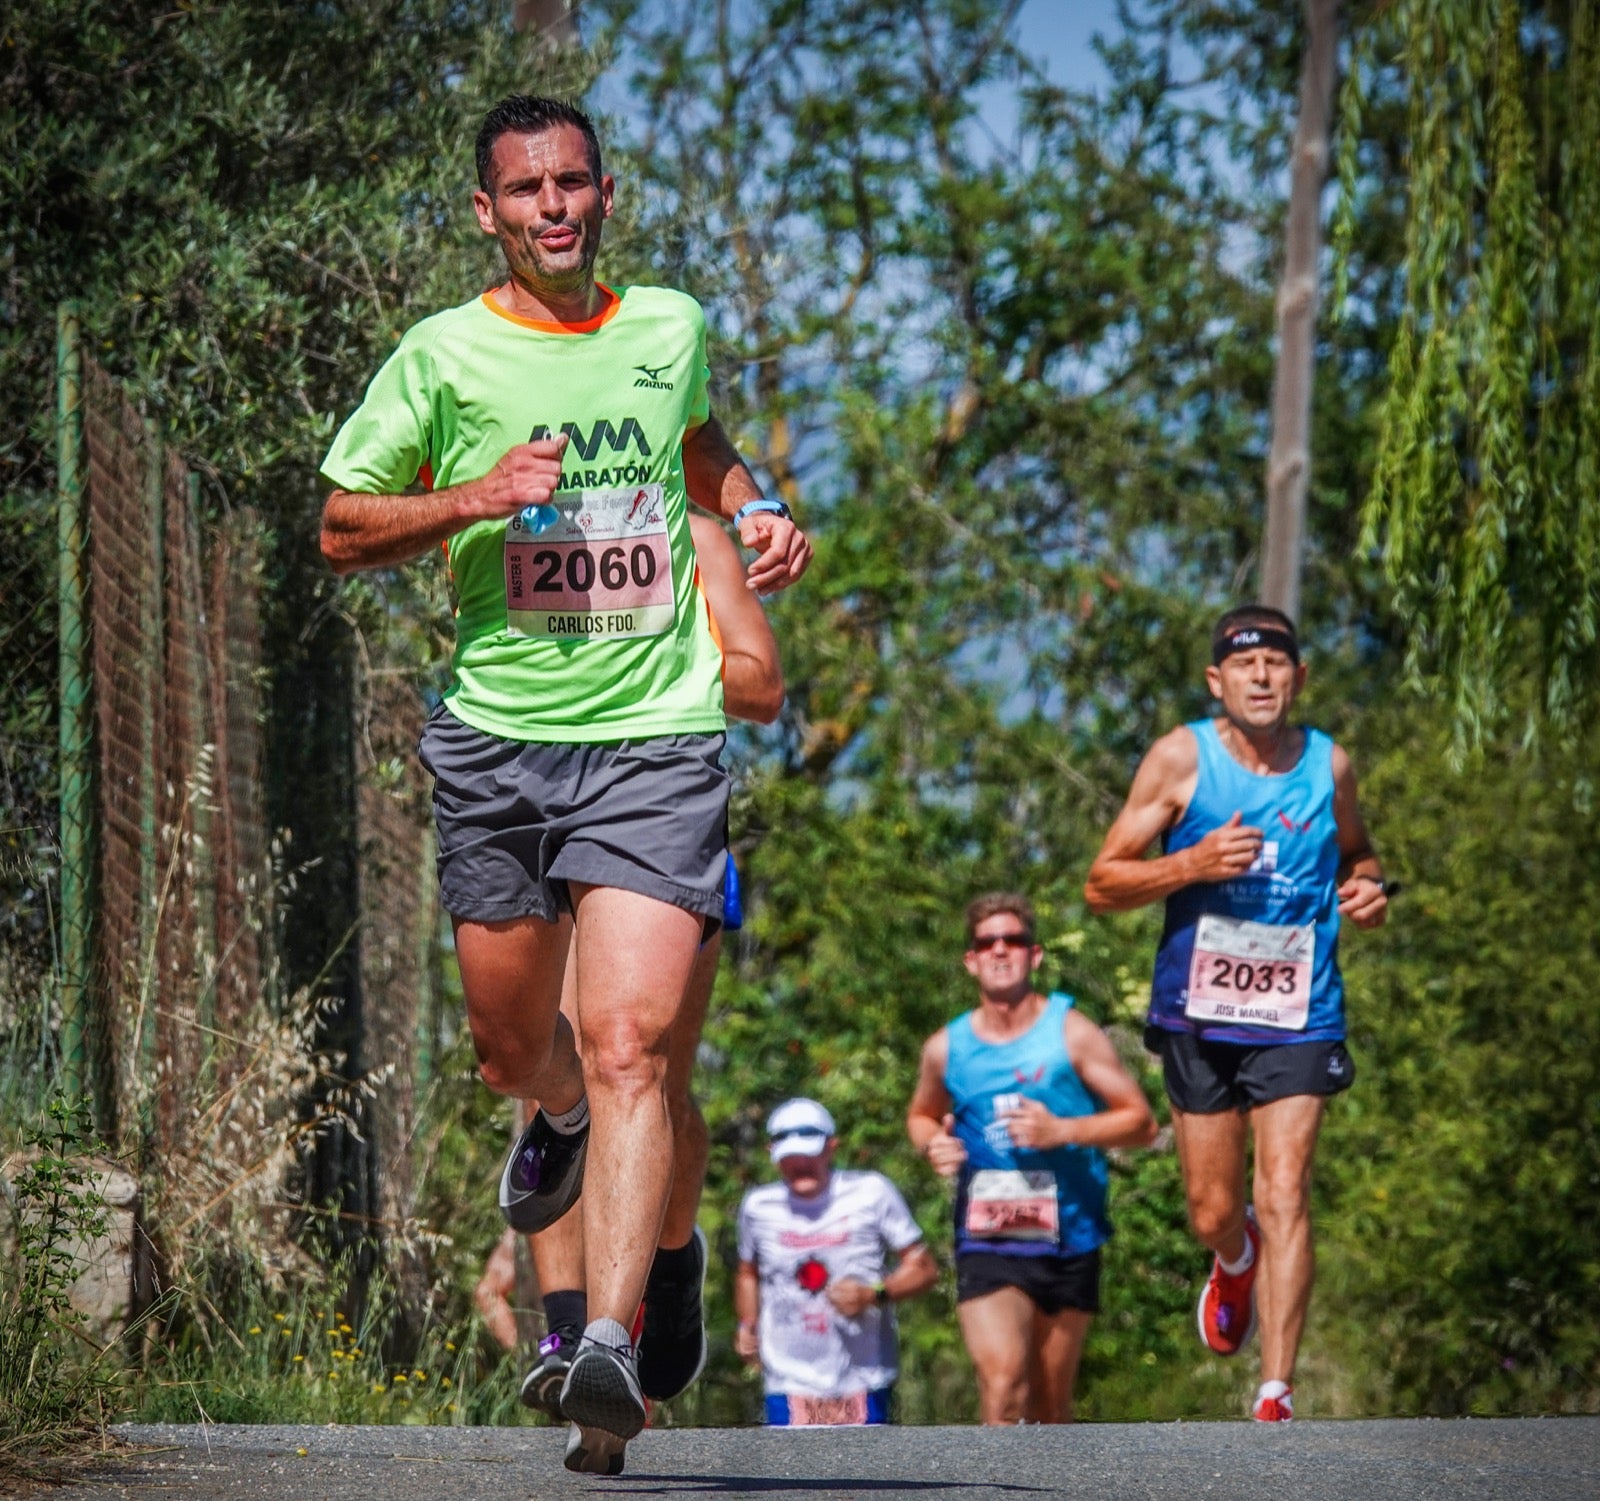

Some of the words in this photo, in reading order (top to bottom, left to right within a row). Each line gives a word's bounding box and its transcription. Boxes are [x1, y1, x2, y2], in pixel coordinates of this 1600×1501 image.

[556, 460, 652, 491] MARATÓN
[512, 563, 523, 598] MASTER
[532, 544, 657, 593] 2060
[547, 615, 604, 634] CARLOS
[607, 614, 637, 632] FDO.
[1232, 631, 1260, 645] FILA
[1210, 958, 1297, 994] 2033
[1214, 1003, 1236, 1017] JOSE
[1239, 1007, 1279, 1022] MANUEL
